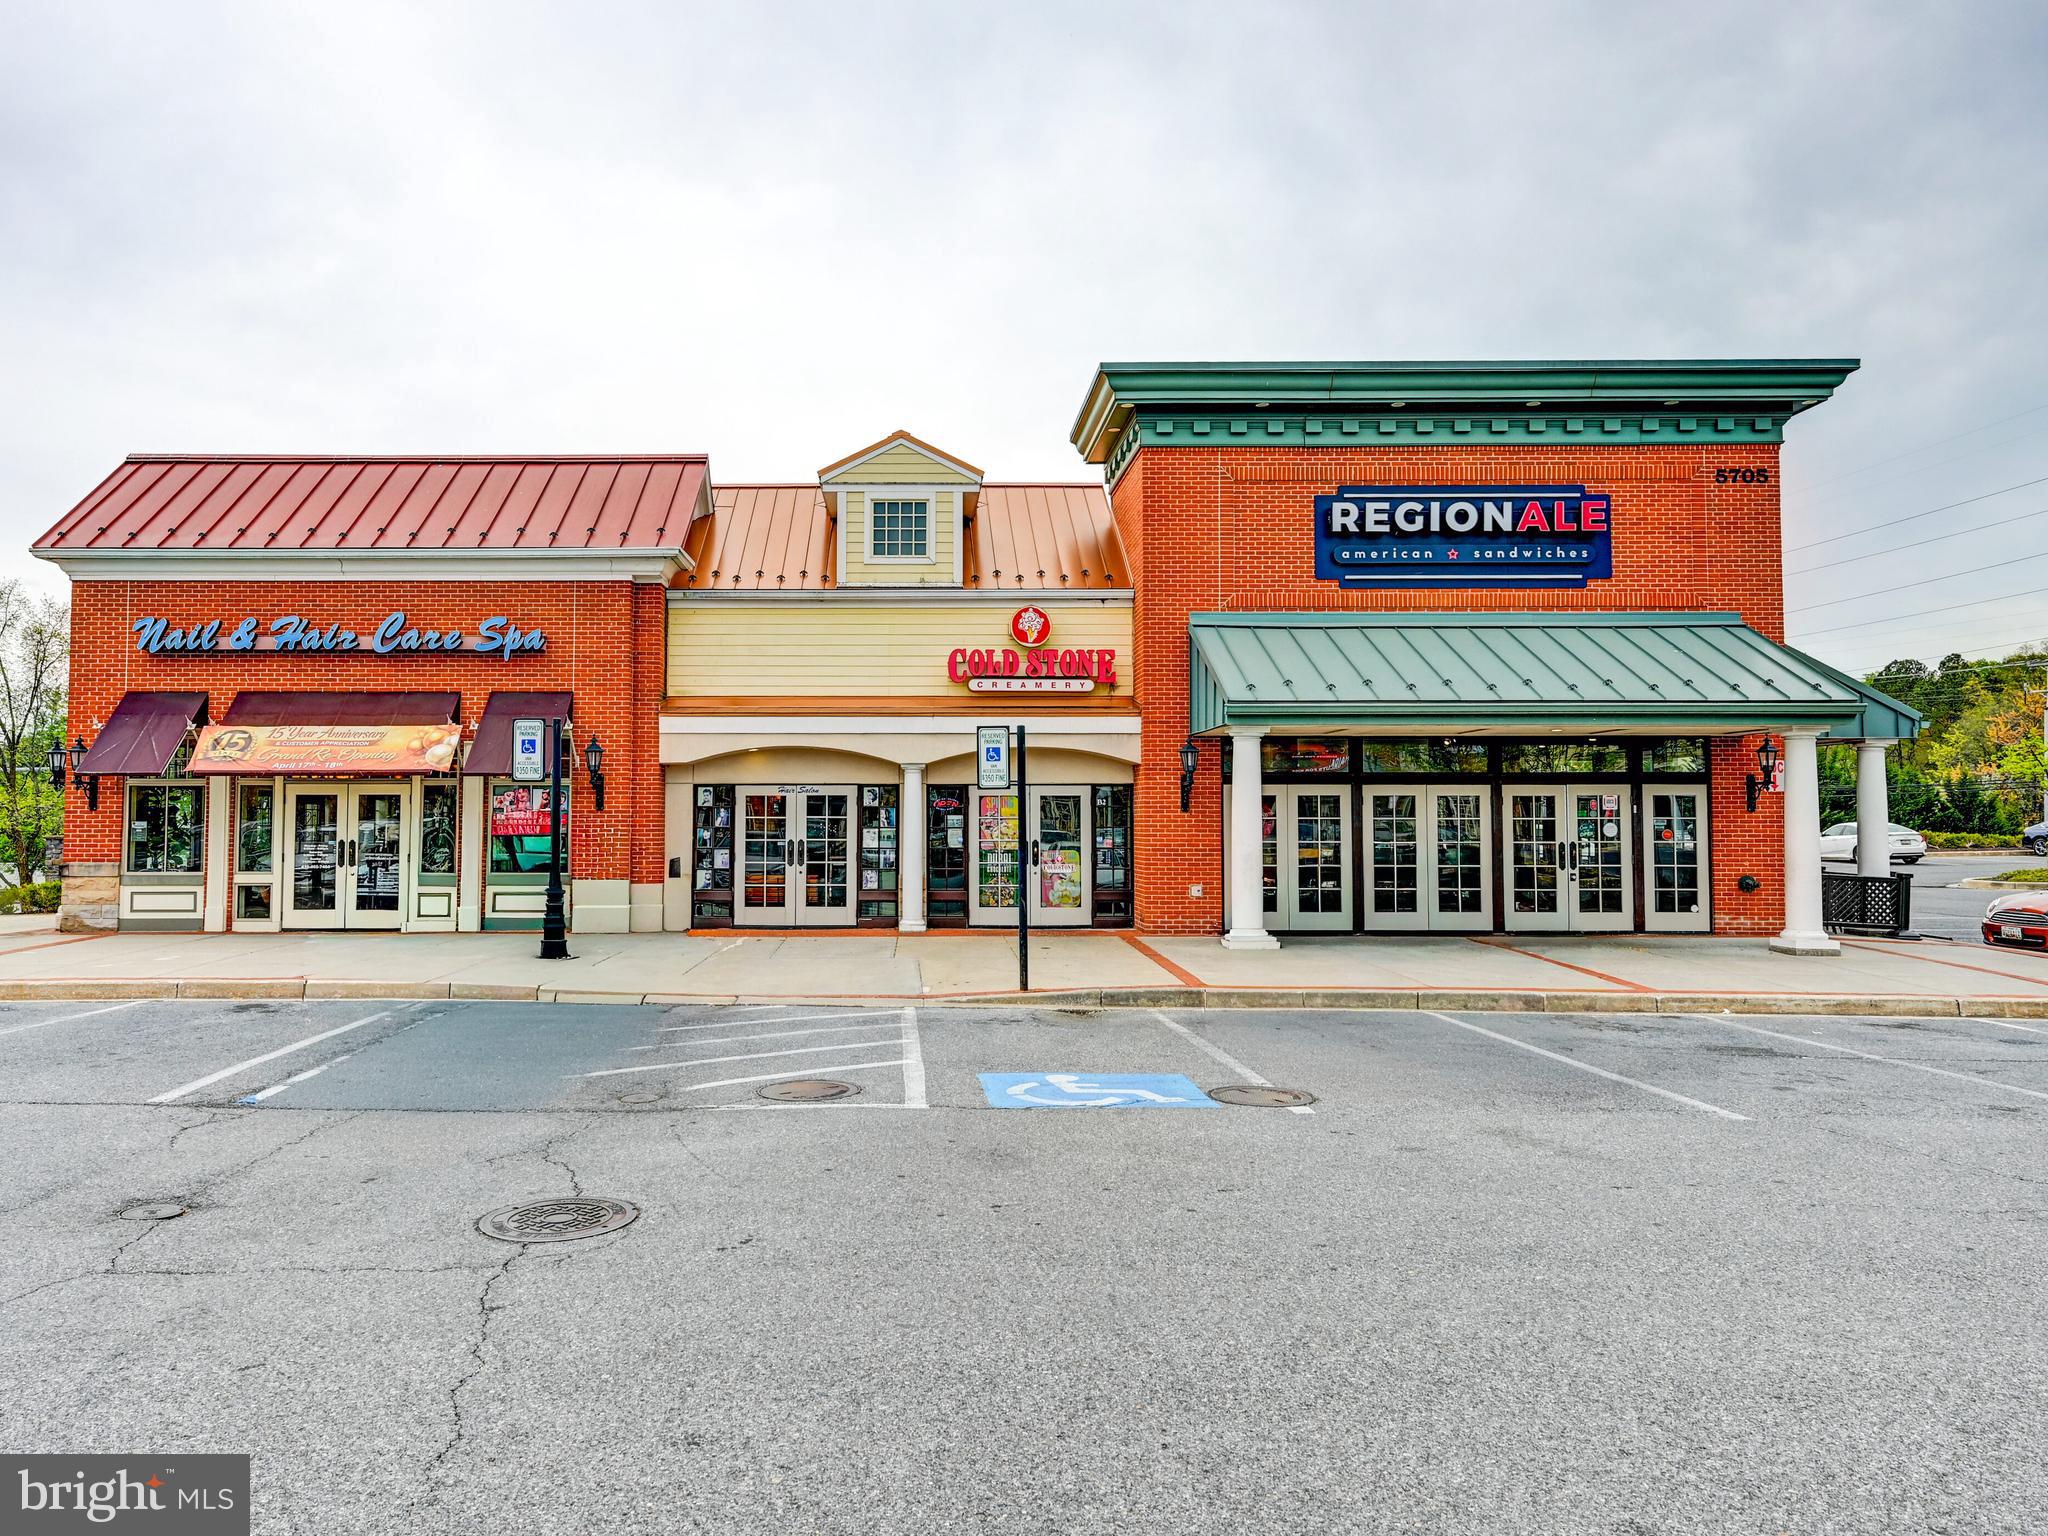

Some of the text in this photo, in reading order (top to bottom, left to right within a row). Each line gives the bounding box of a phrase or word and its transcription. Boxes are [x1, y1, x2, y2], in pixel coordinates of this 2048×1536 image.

[1716, 468, 1769, 484] 5705
[1331, 500, 1608, 533] REGIONALE
[1342, 546, 1589, 559] american sandwiches
[132, 611, 547, 662] Nail & Hair Care Spa
[947, 648, 1118, 684] COLD STONE
[976, 681, 1087, 689] CREAMERY
[266, 726, 390, 740] 15 Year Anniversary
[217, 733, 252, 750] 15
[257, 747, 399, 762] Grand Re-Opening
[530, 766, 540, 775] FINE
[996, 774, 1006, 783] FINE
